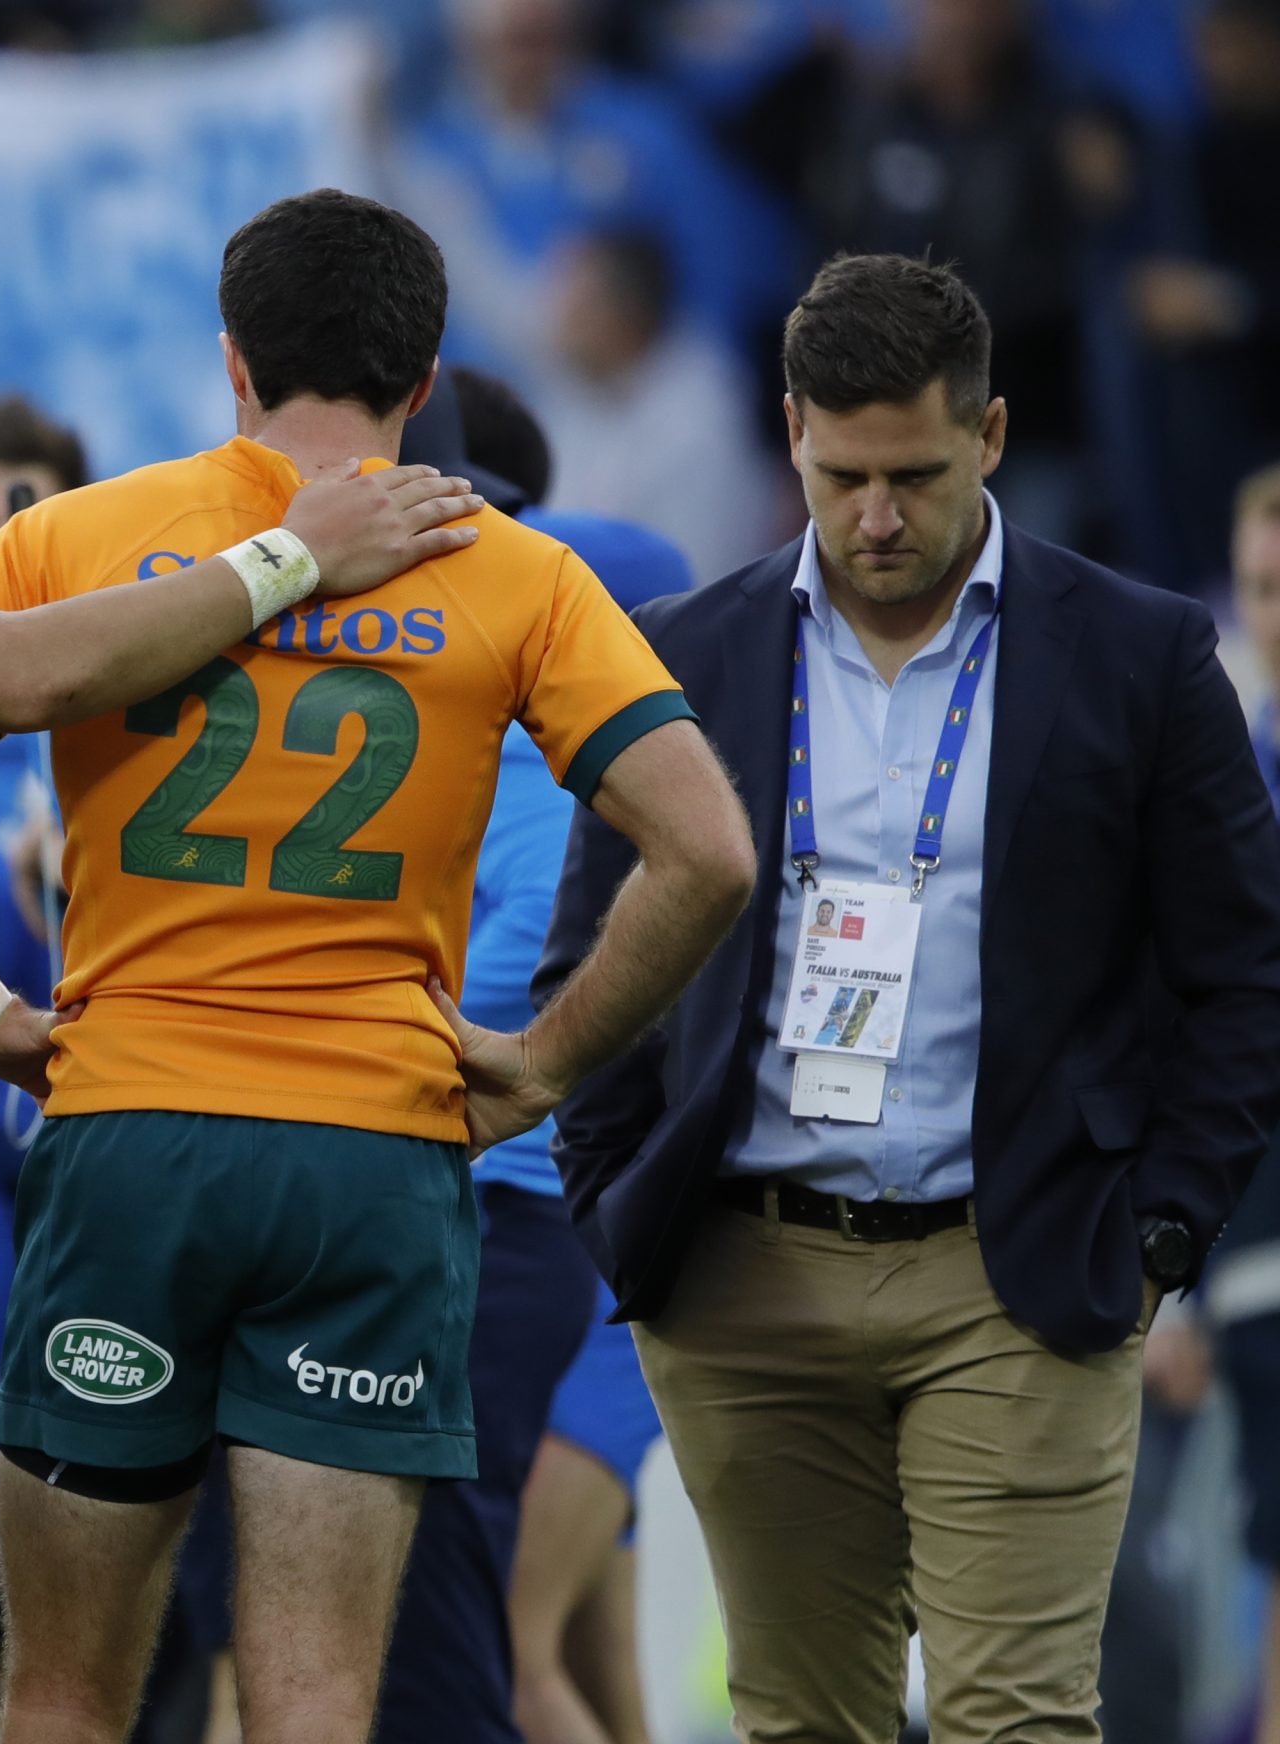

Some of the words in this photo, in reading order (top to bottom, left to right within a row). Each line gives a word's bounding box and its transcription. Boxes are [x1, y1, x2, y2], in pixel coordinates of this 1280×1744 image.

[120, 655, 419, 901] 22
[844, 899, 865, 907] TEAM
[806, 964, 837, 977] ITALIA
[839, 967, 850, 978] VS
[851, 968, 902, 983] AUSTRALIA
[64, 1333, 123, 1360] LAND
[71, 1357, 145, 1386] ROVER
